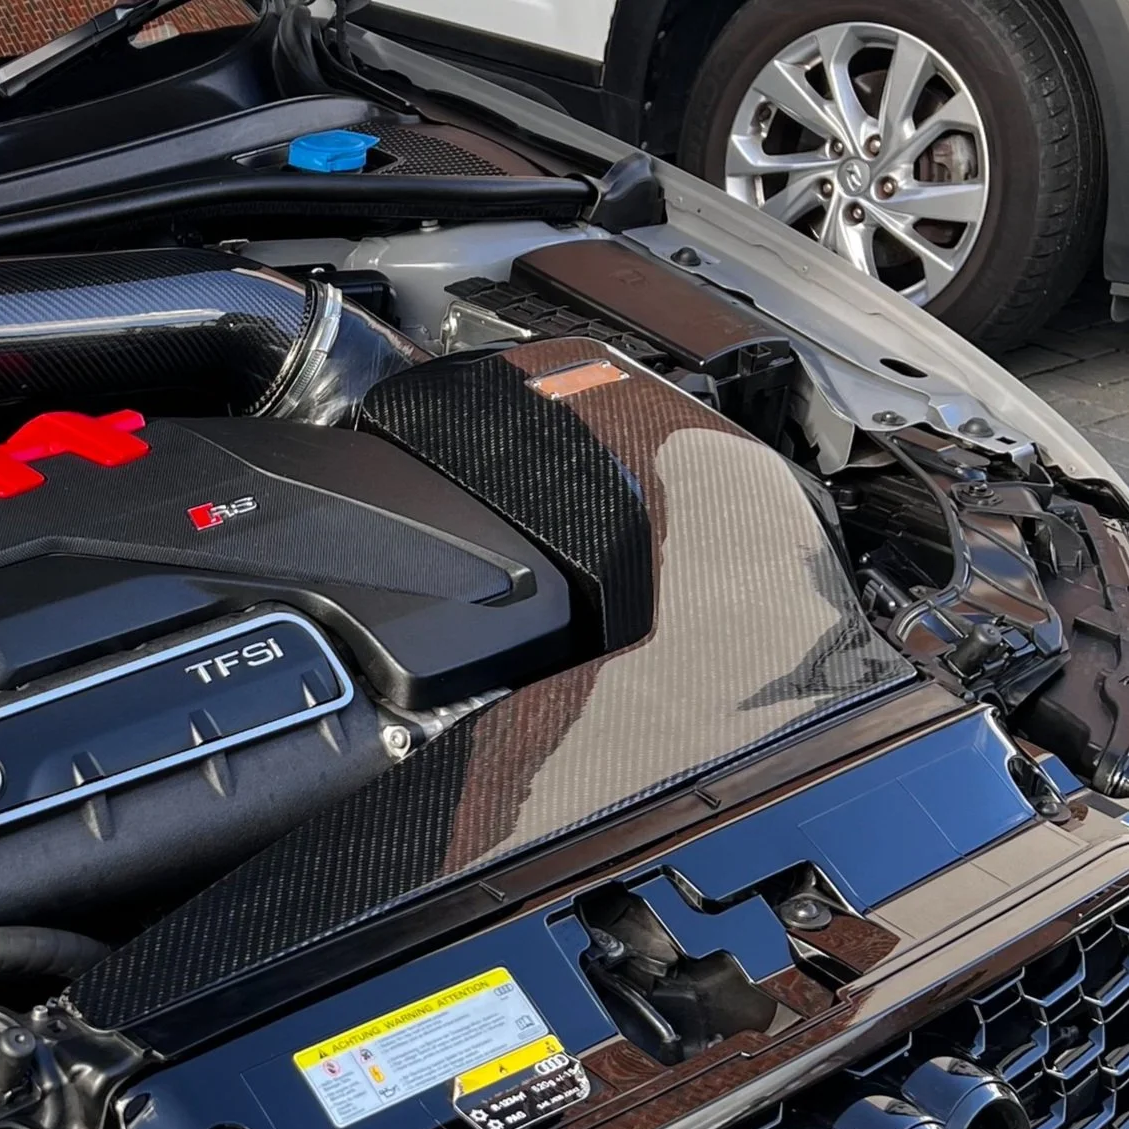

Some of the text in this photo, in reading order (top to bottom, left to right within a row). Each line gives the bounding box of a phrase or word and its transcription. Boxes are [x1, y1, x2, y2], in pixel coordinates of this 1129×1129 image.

[184, 638, 284, 684] TFSI
[332, 979, 489, 1053] ACHTUNG WARNING ATTENTION
